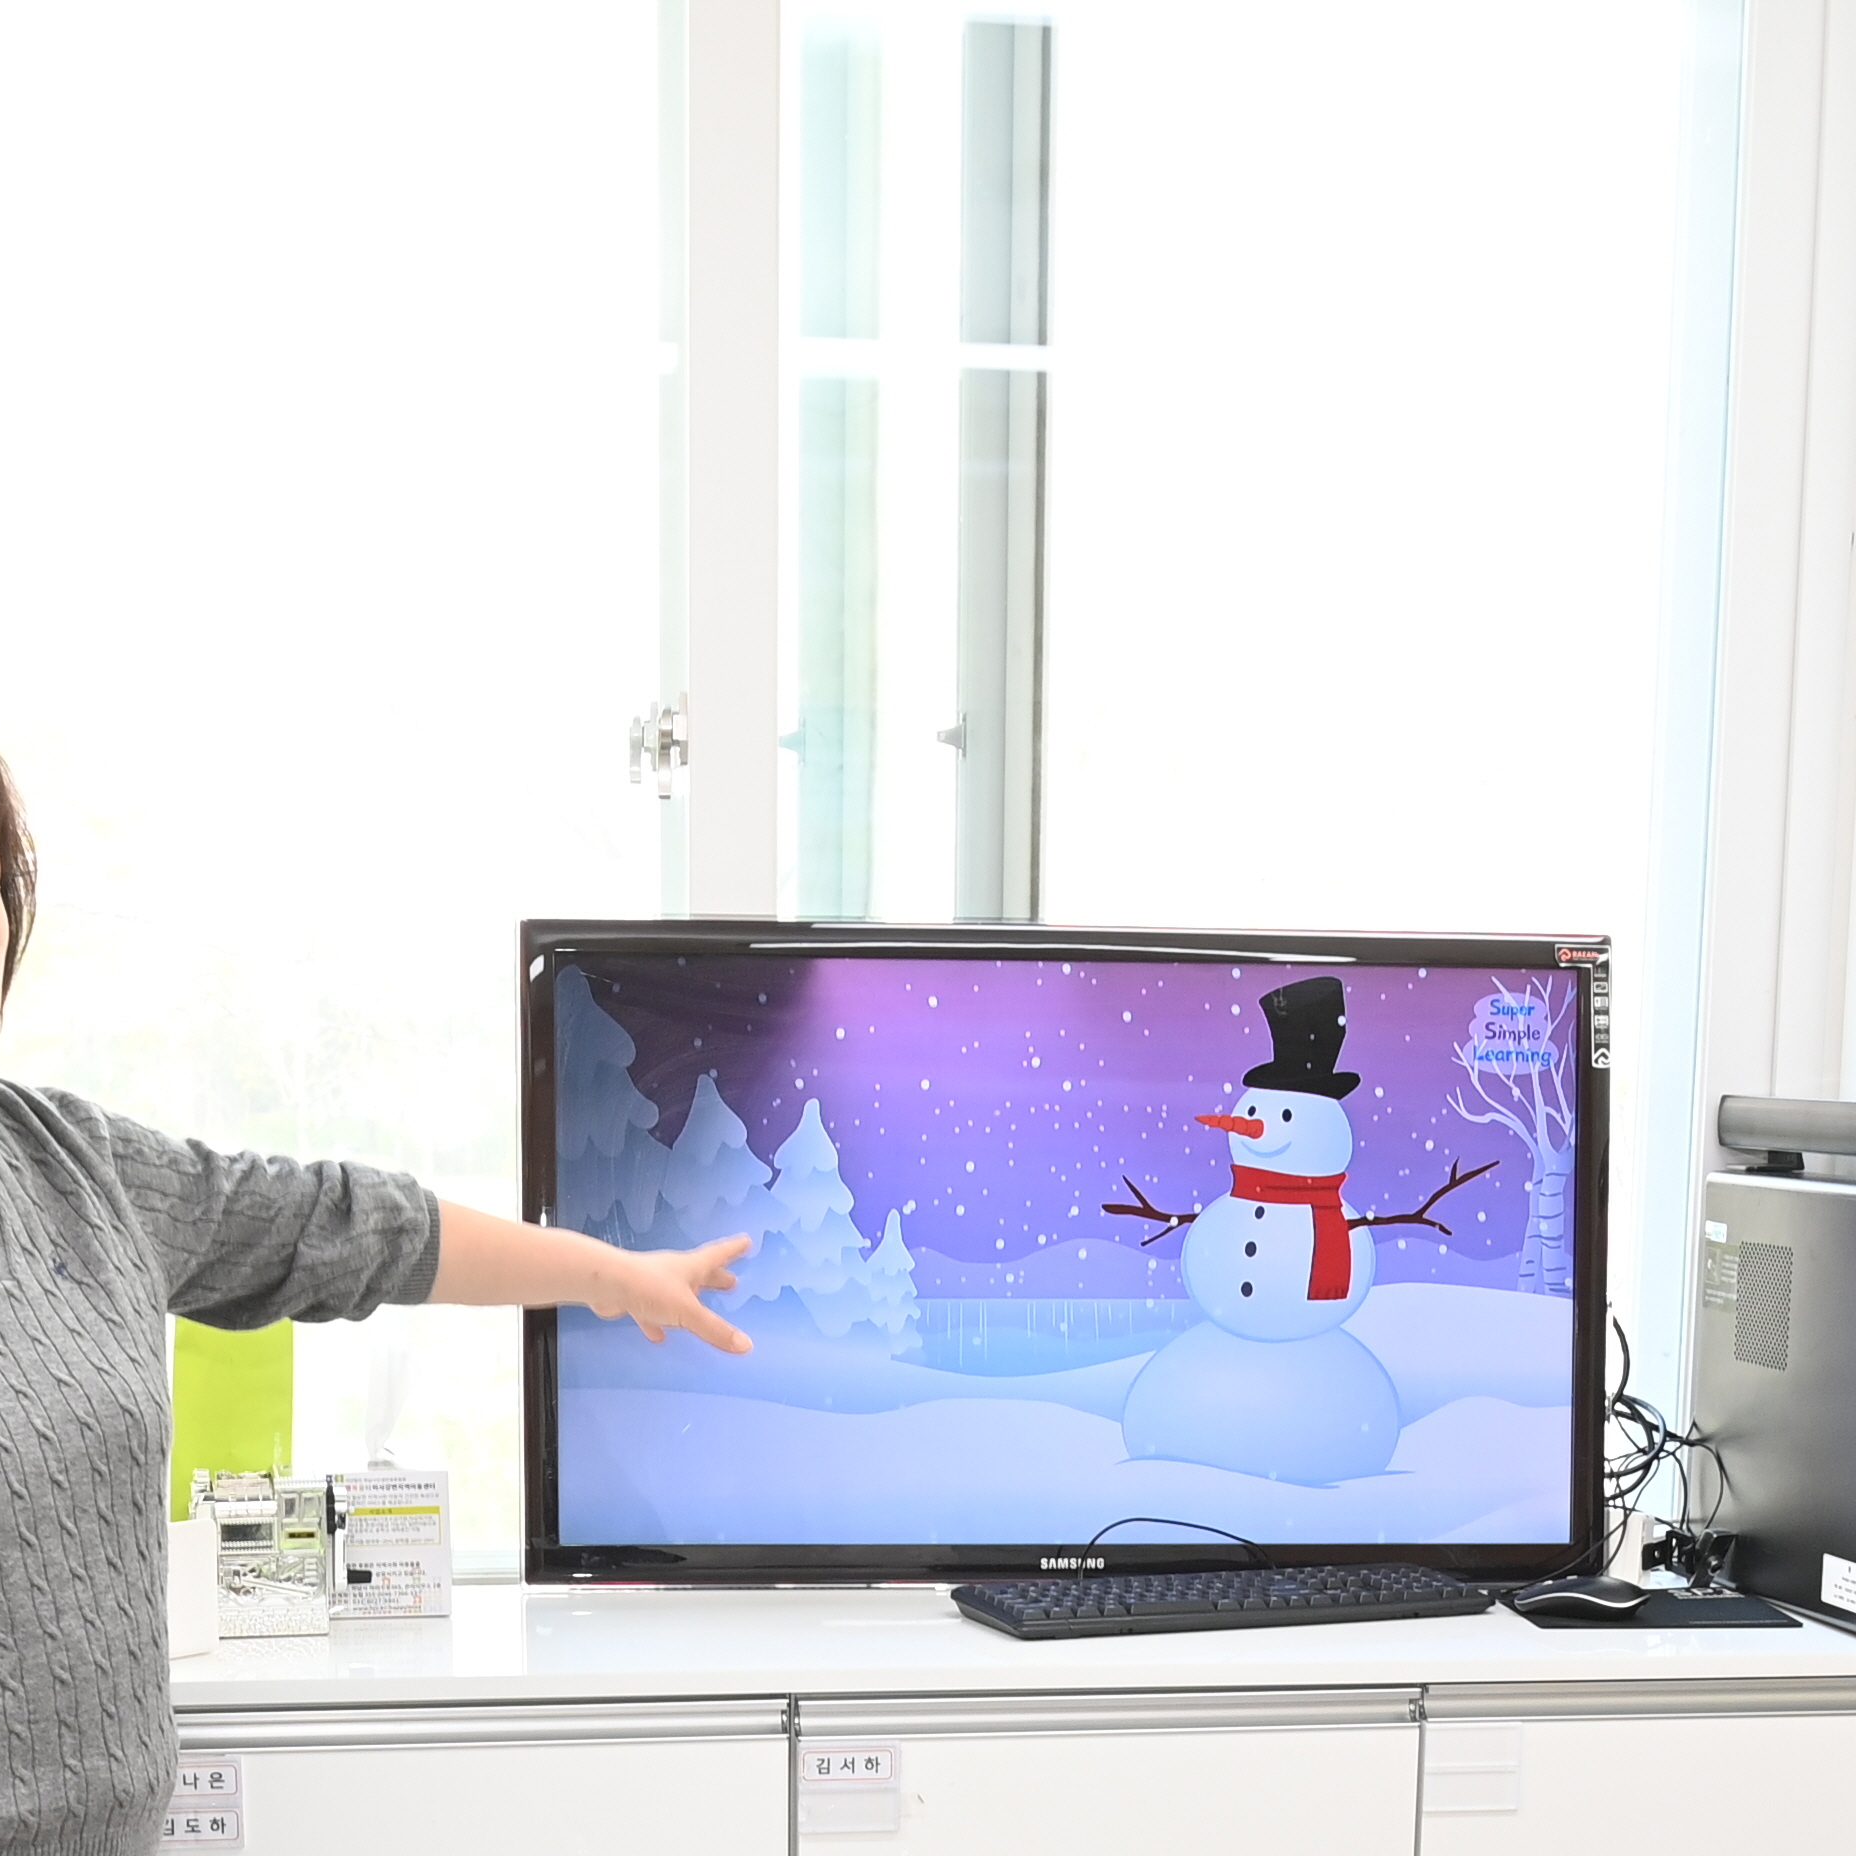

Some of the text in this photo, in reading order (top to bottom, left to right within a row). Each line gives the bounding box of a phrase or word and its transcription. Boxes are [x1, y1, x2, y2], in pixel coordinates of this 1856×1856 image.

[1489, 998, 1535, 1021] Super
[1484, 1021, 1541, 1045] Simple
[1473, 1044, 1552, 1067] Learning
[816, 1755, 881, 1775] 김서하
[182, 1771, 226, 1790] 나은
